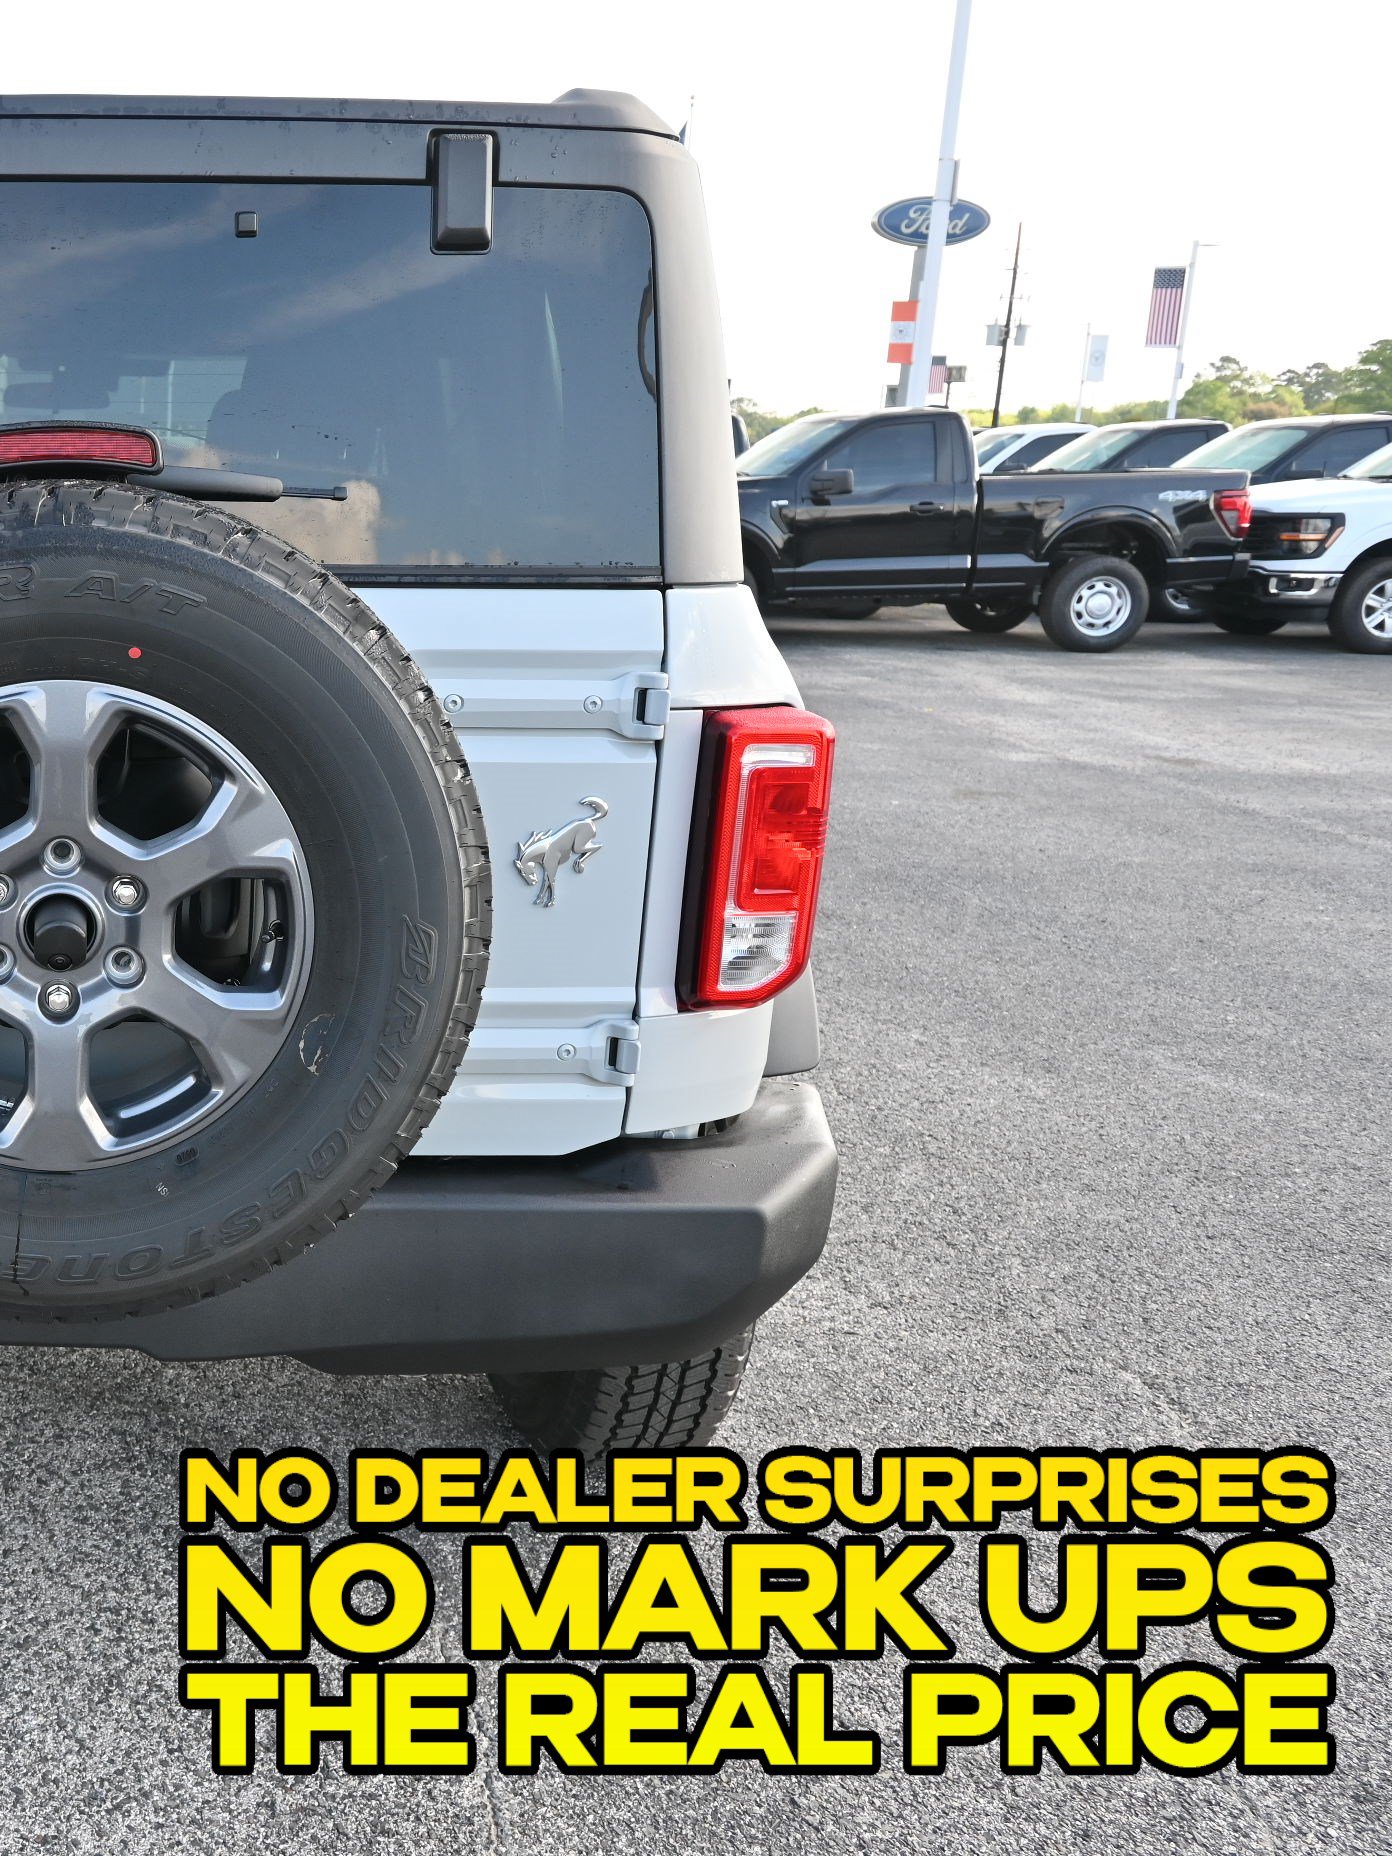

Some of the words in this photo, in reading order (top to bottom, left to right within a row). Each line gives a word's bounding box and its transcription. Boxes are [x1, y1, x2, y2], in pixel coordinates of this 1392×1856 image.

[900, 203, 971, 234] Fod
[64, 569, 209, 617] A/T
[15, 912, 440, 1285] BRIDGESTONE
